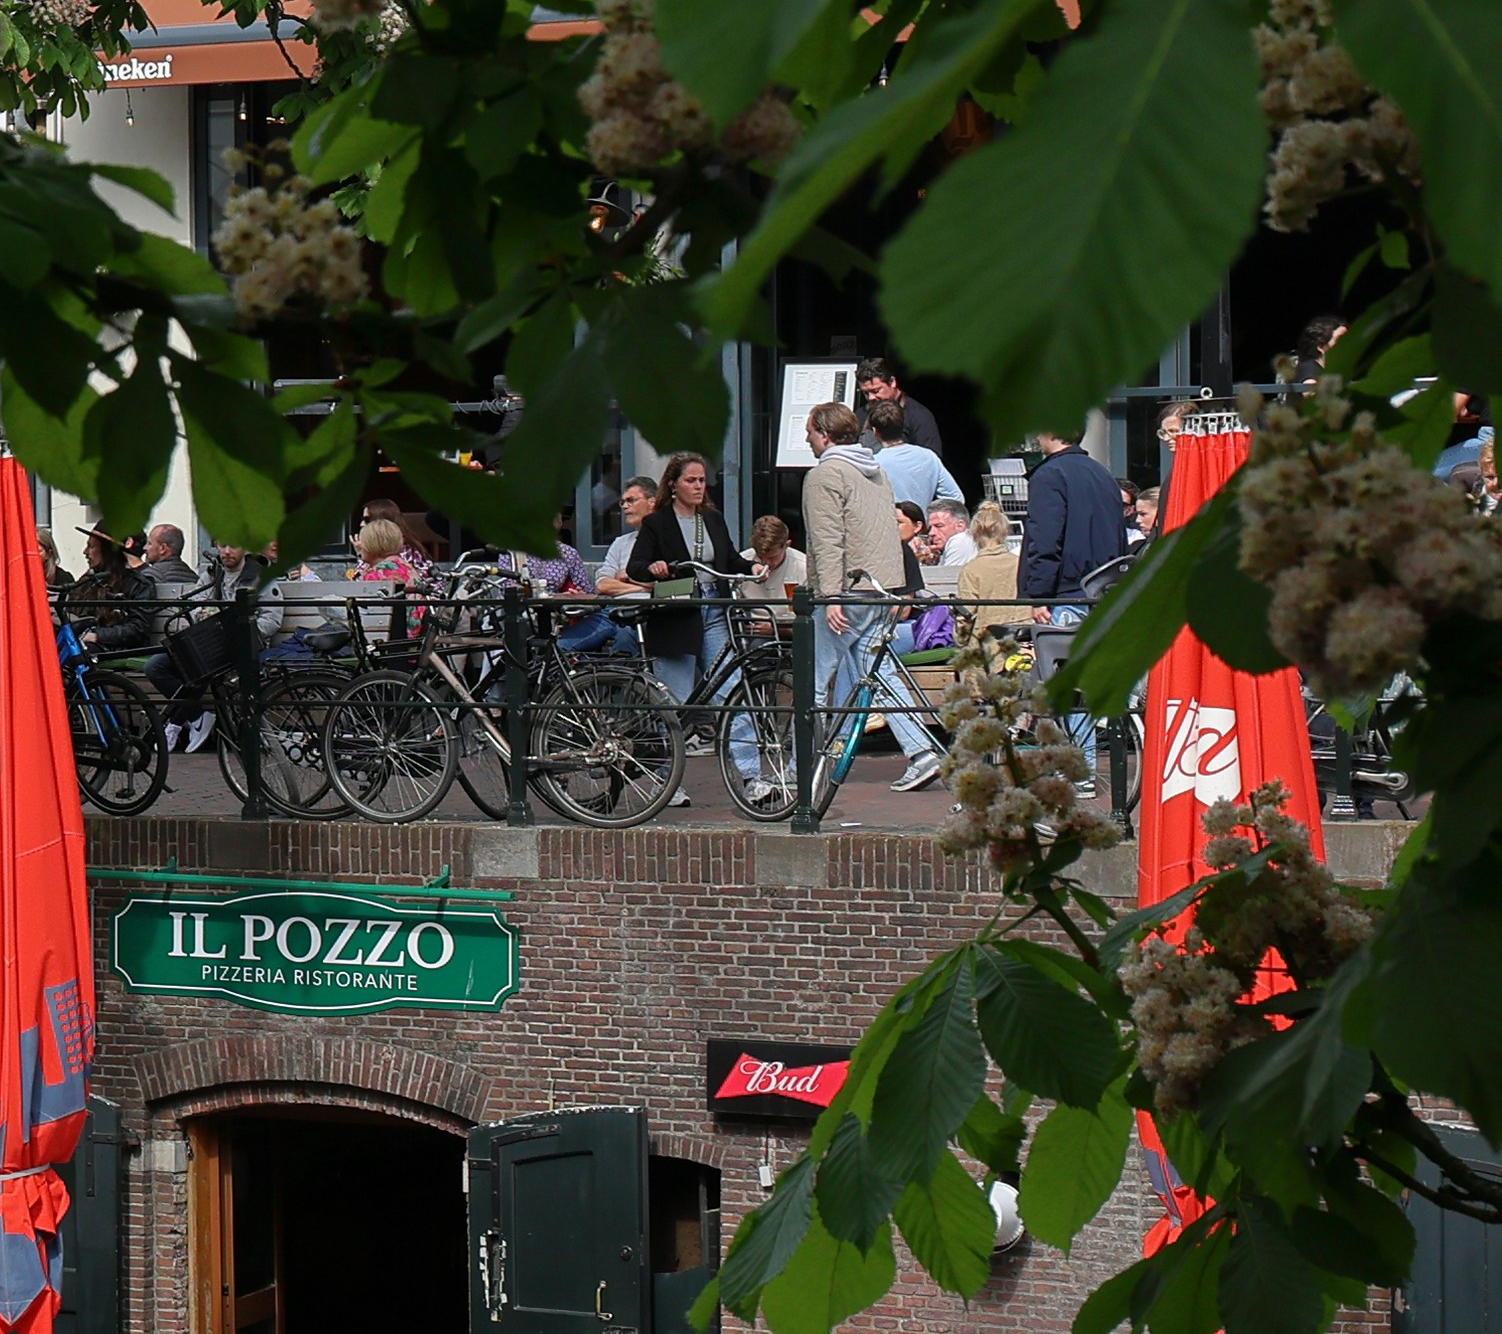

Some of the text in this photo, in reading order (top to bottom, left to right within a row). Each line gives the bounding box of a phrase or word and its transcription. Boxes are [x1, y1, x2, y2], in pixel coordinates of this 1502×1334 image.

[97, 57, 172, 82] ineken
[167, 911, 455, 970] IL POZZO
[202, 964, 418, 991] PIZZERIA RISTORANTE
[740, 1060, 820, 1093] Bud
